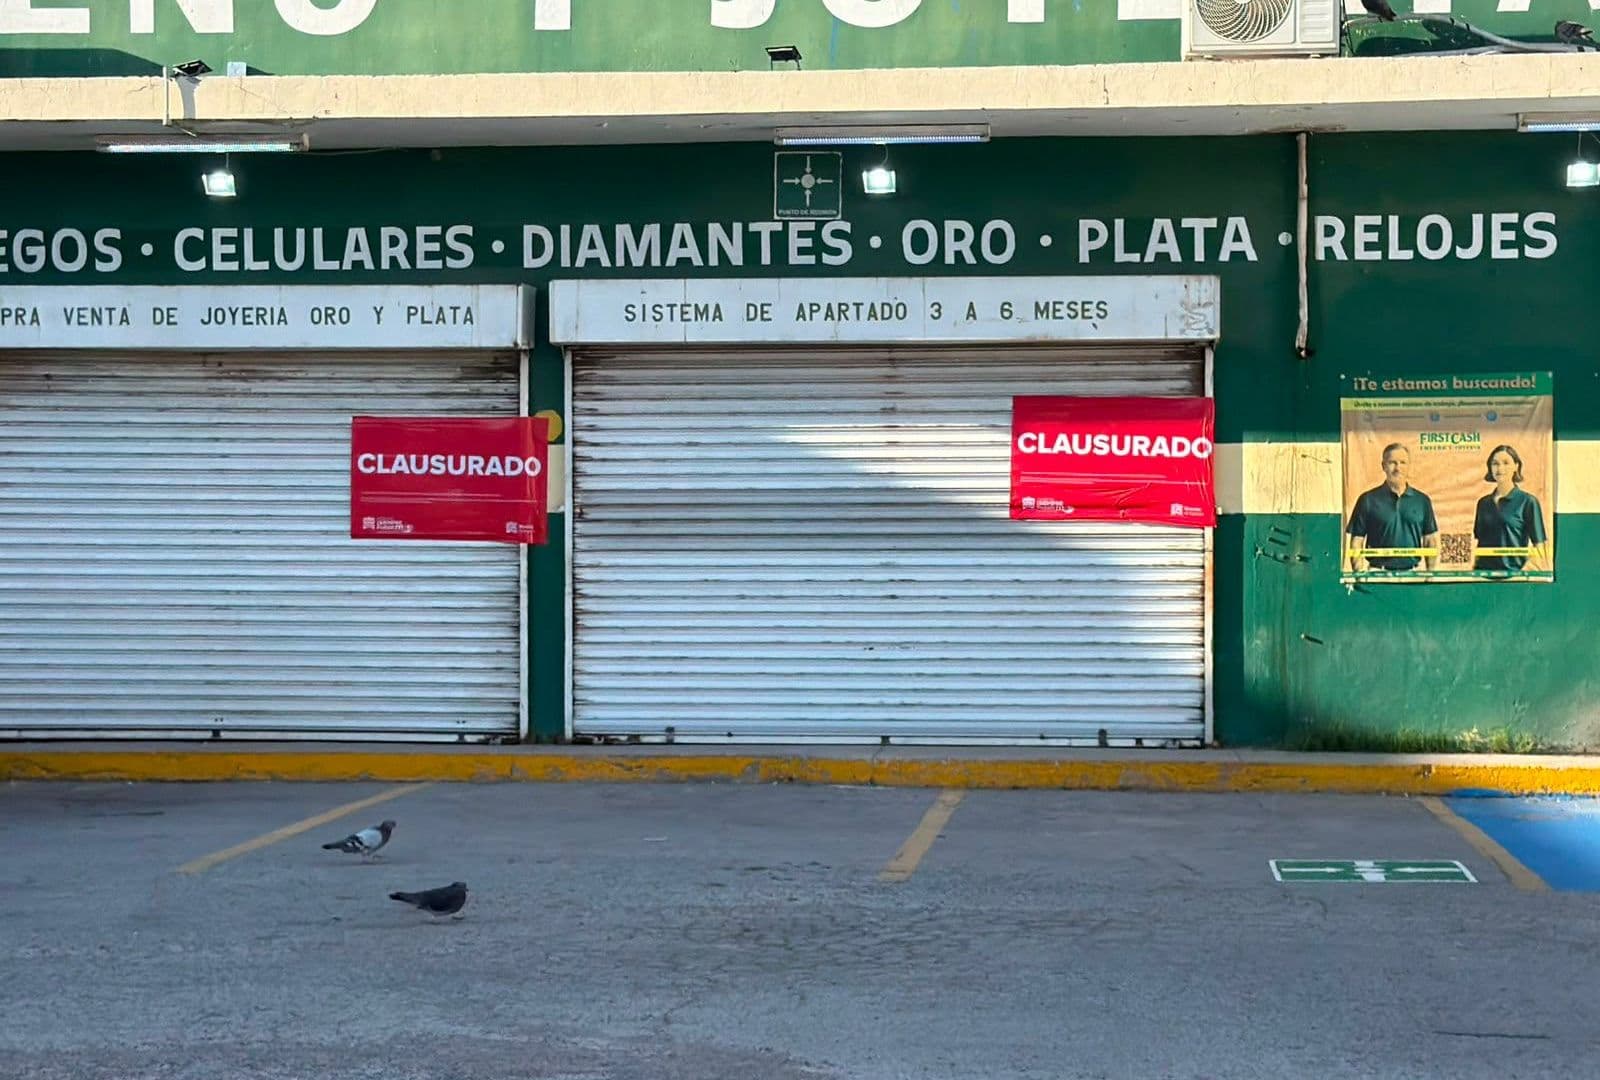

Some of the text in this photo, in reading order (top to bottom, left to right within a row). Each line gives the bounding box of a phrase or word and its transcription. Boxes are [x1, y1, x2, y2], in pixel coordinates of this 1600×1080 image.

[174, 225, 475, 271] CELULARES
[523, 220, 853, 268] DIAMANTES
[902, 219, 1016, 265] ORO
[1078, 217, 1258, 263] PLATA
[1315, 212, 1558, 261] RELOJES
[1, 306, 474, 326] PRA VENTA DE JOYERIA ORO Y PLATA
[624, 301, 1108, 322] SISTEMA DE APARTADO 3 A 6 MESES
[1354, 375, 1537, 391] ¡Te estamos buscando!
[1017, 432, 1213, 459] CLAUSURADO
[357, 453, 541, 477] CLAUSURADO
